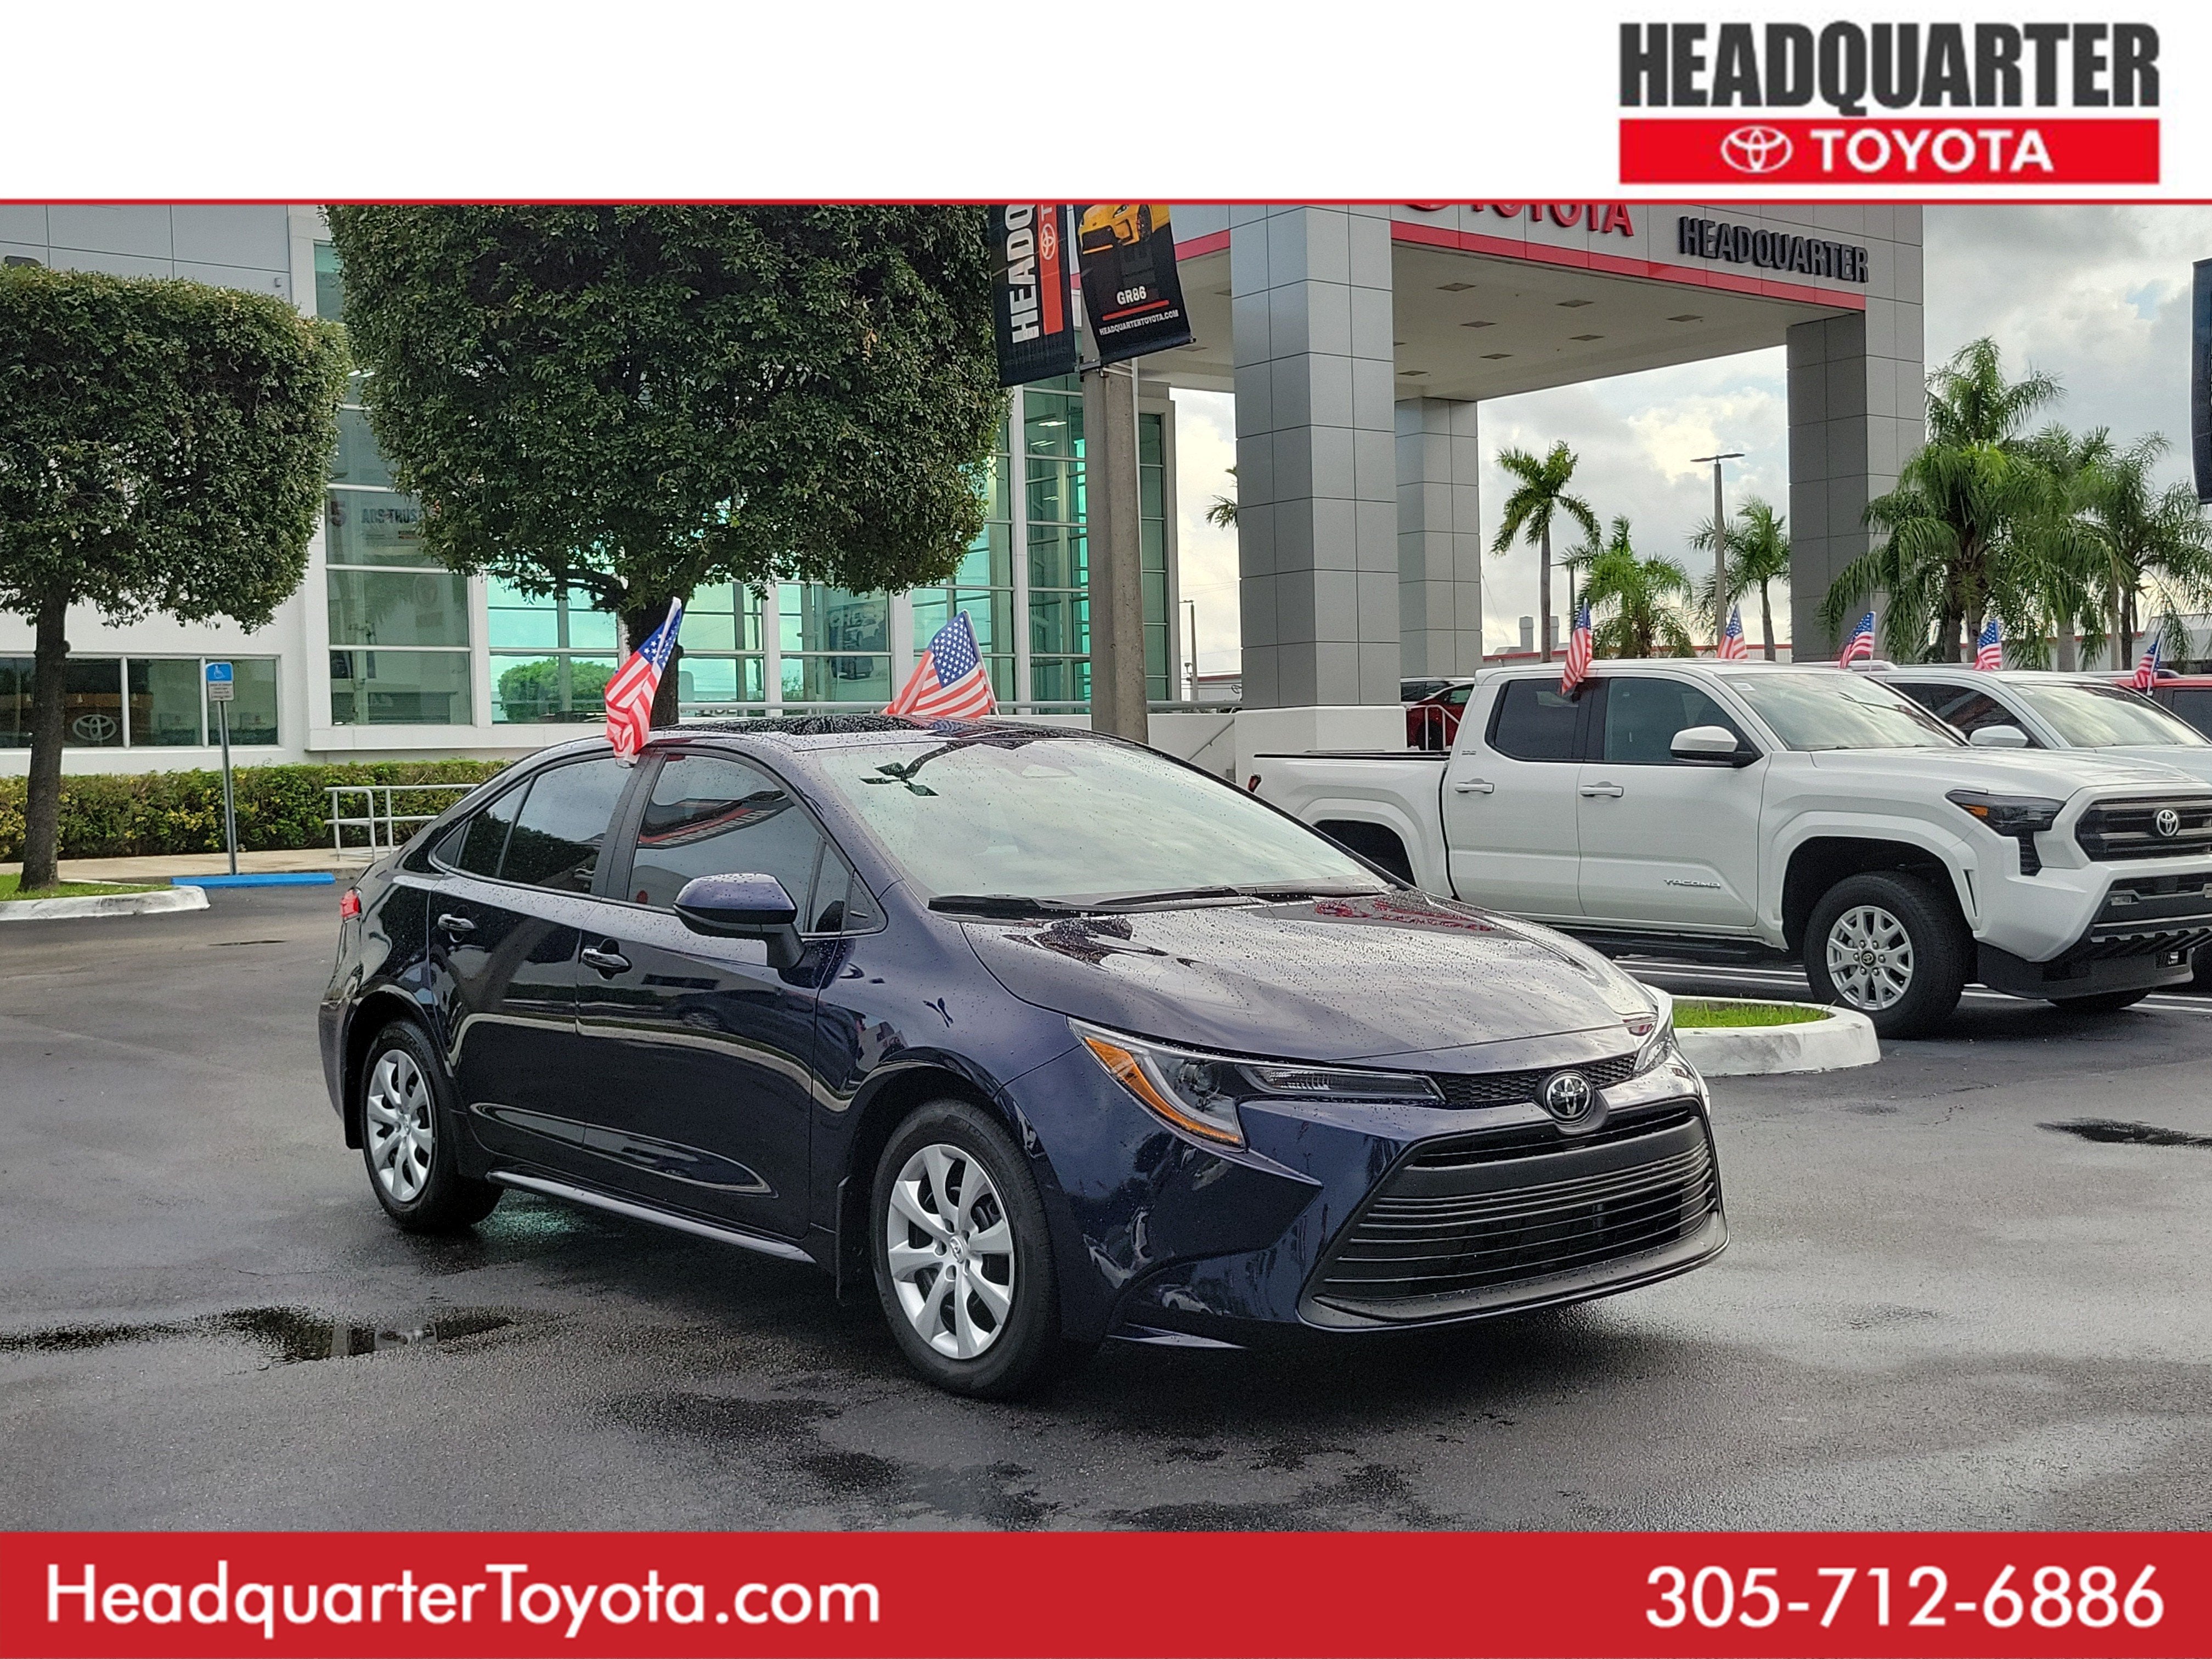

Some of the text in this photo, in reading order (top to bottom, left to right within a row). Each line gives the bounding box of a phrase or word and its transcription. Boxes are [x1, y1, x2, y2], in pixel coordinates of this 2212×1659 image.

[1678, 216, 1869, 283] HEADQUARTER
[1116, 285, 1147, 305] GR86
[1099, 309, 1179, 336] HEADQUARTERTOYOTA.COM
[1663, 878, 1720, 889] TACOMA
